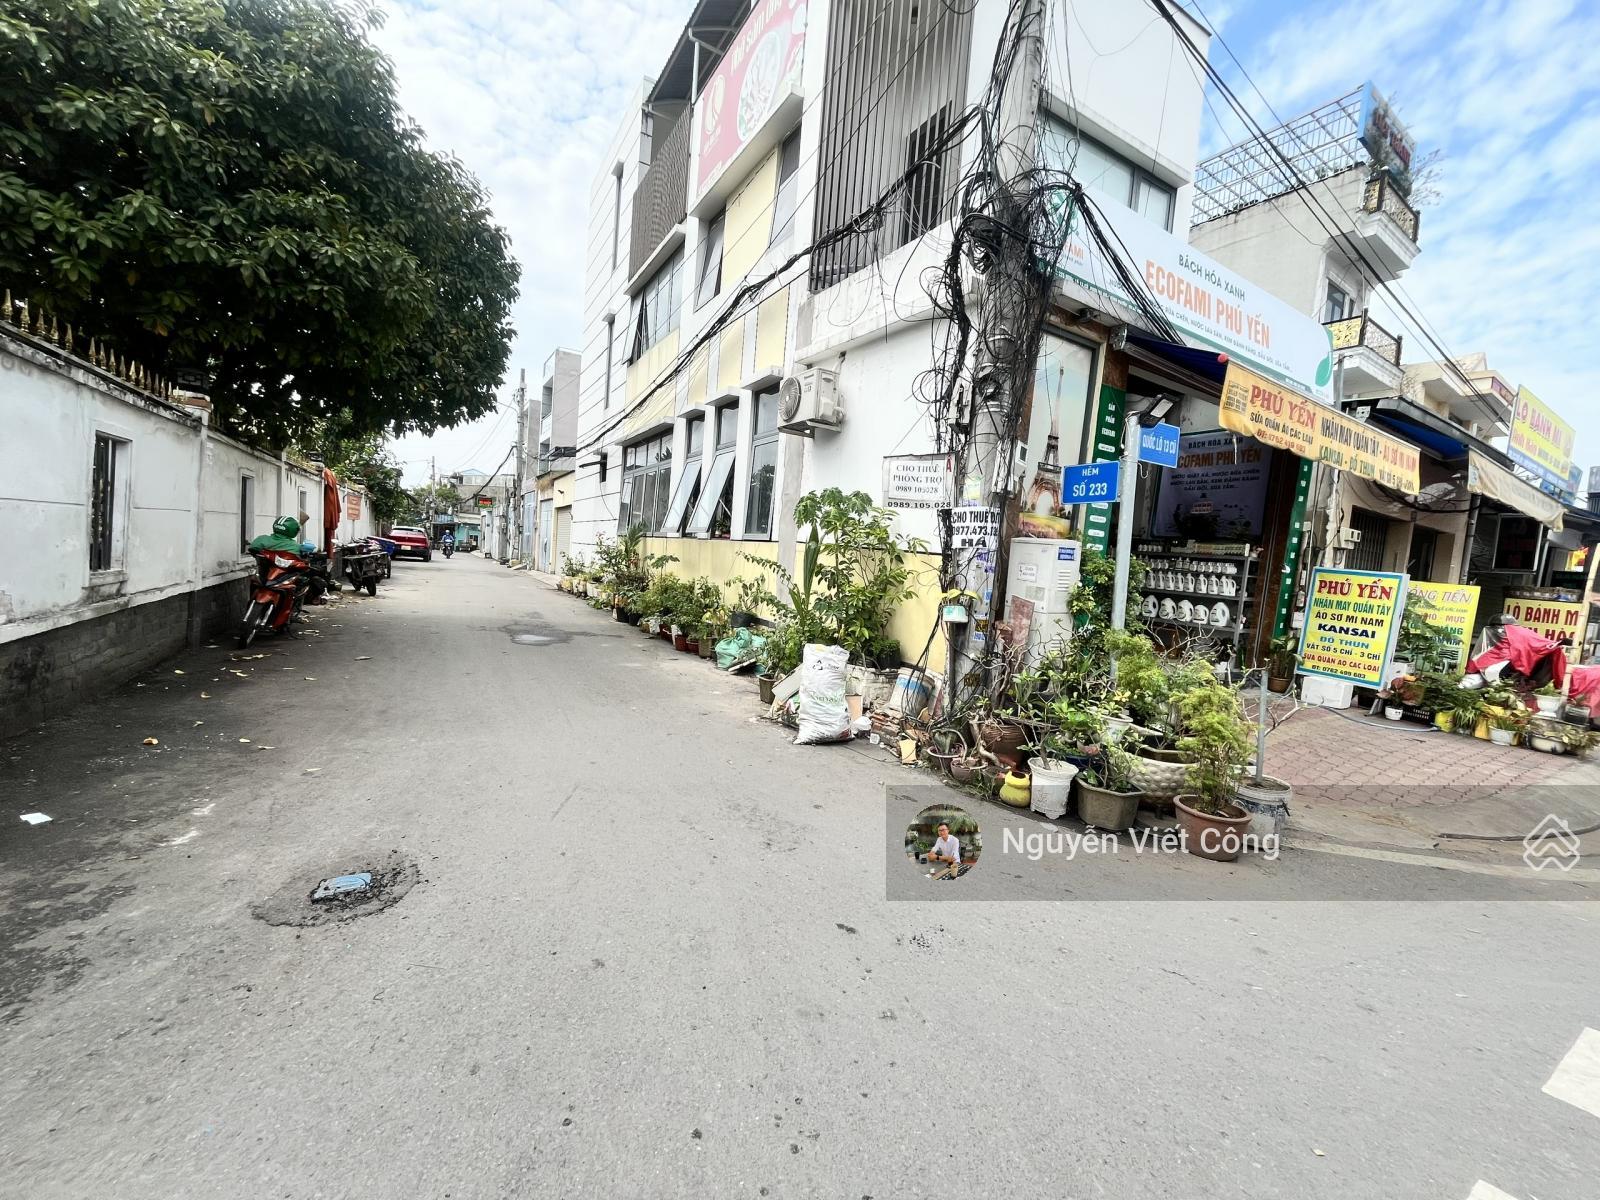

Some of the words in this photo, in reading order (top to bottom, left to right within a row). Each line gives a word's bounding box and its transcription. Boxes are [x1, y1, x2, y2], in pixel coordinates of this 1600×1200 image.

[1178, 253, 1203, 278] BÁCH
[1204, 269, 1222, 289] HÓA
[1224, 280, 1246, 302] XANH
[1145, 259, 1212, 320] ECOFAMI
[1216, 297, 1243, 336] PHÚ
[1247, 313, 1270, 349] YẾN
[1250, 383, 1284, 416] PHÚ
[1287, 399, 1316, 429] YẾN
[1142, 431, 1155, 450] QUỐC
[1223, 436, 1243, 446] XAH
[1339, 424, 1353, 447] MAY
[896, 464, 915, 473] CHO
[1178, 450, 1214, 469] COFAMI
[1072, 479, 1088, 497] SỐ
[1089, 482, 1108, 496] 233
[952, 512, 967, 523] CHO
[968, 509, 989, 523] THUÊ
[1317, 578, 1352, 596] PHÚ
[1357, 579, 1393, 600] YẾN
[1335, 600, 1352, 611] MAY
[1524, 604, 1561, 624] BÁNH
[1564, 609, 1579, 626] M
[1315, 608, 1327, 620] ÁO
[1330, 612, 1344, 622] SƠ
[1360, 617, 1384, 628] NAM
[1317, 623, 1377, 639] KANSAI
[1339, 638, 1370, 649] THUN
